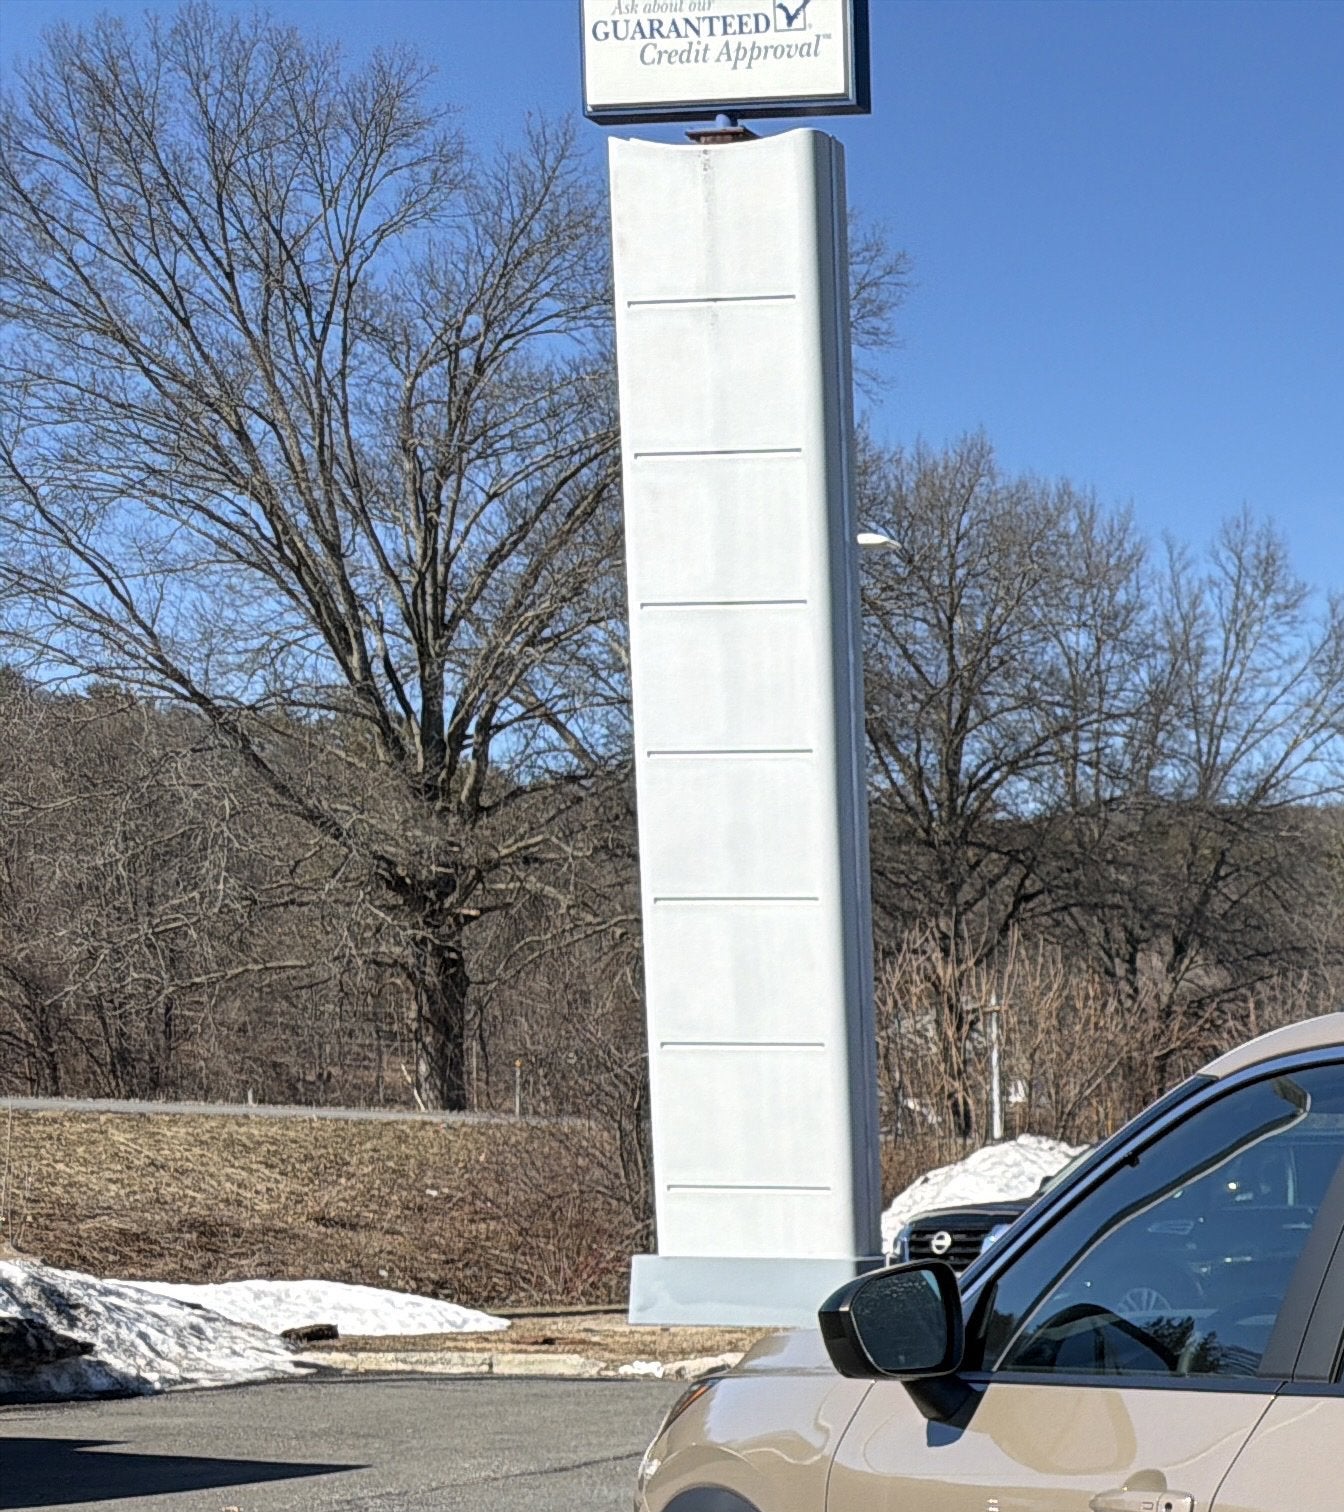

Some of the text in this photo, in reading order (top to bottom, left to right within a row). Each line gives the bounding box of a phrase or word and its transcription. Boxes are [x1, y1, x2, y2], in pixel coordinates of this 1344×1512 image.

[610, 0, 713, 16] Ask about our
[592, 12, 770, 41] GUARANTEED
[639, 34, 822, 70] Credit Approval
